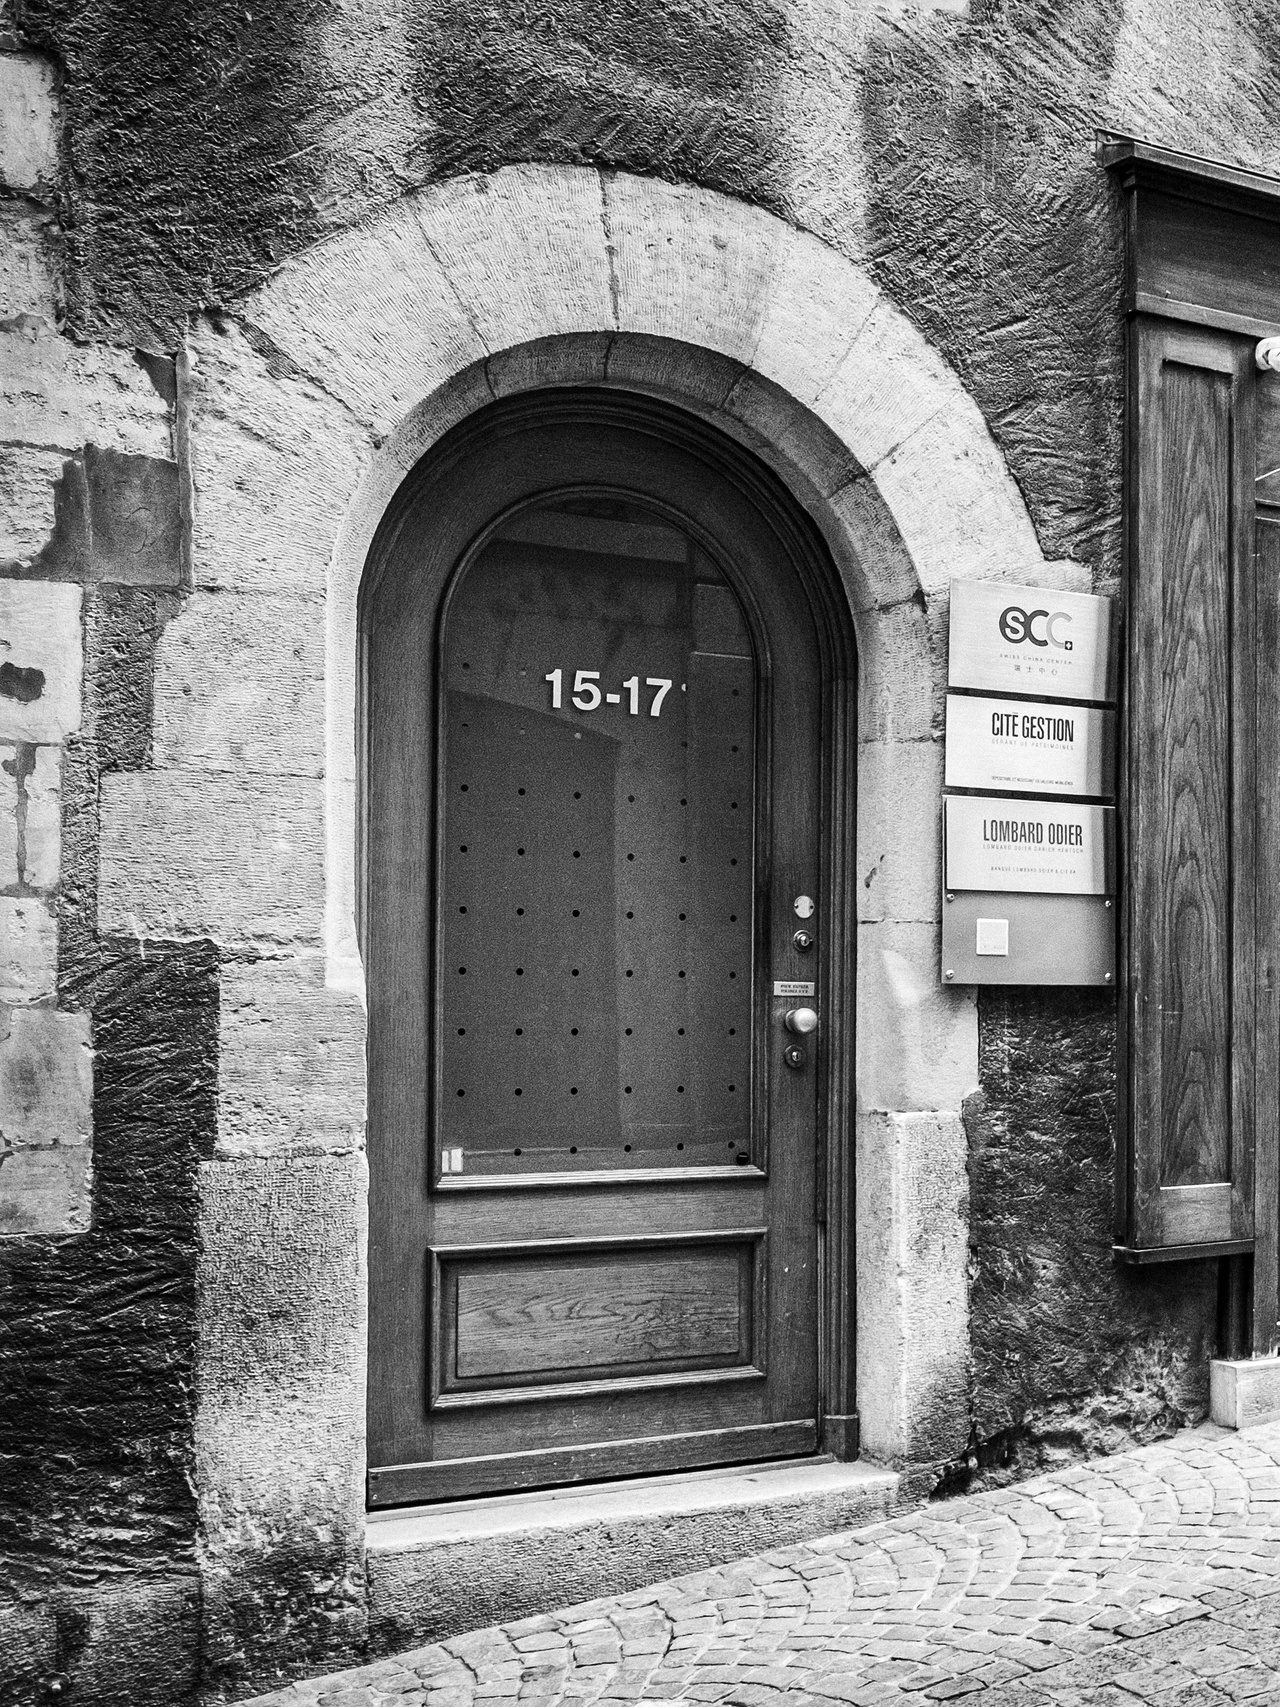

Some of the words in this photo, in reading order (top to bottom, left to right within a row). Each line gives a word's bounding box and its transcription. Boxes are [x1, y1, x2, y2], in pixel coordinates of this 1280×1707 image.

[999, 606, 1073, 648] SCC
[545, 668, 673, 717] 15-17
[1022, 714, 1074, 742] GESTION
[983, 819, 1043, 844] LOMBARD
[1048, 823, 1083, 846] ODIER
